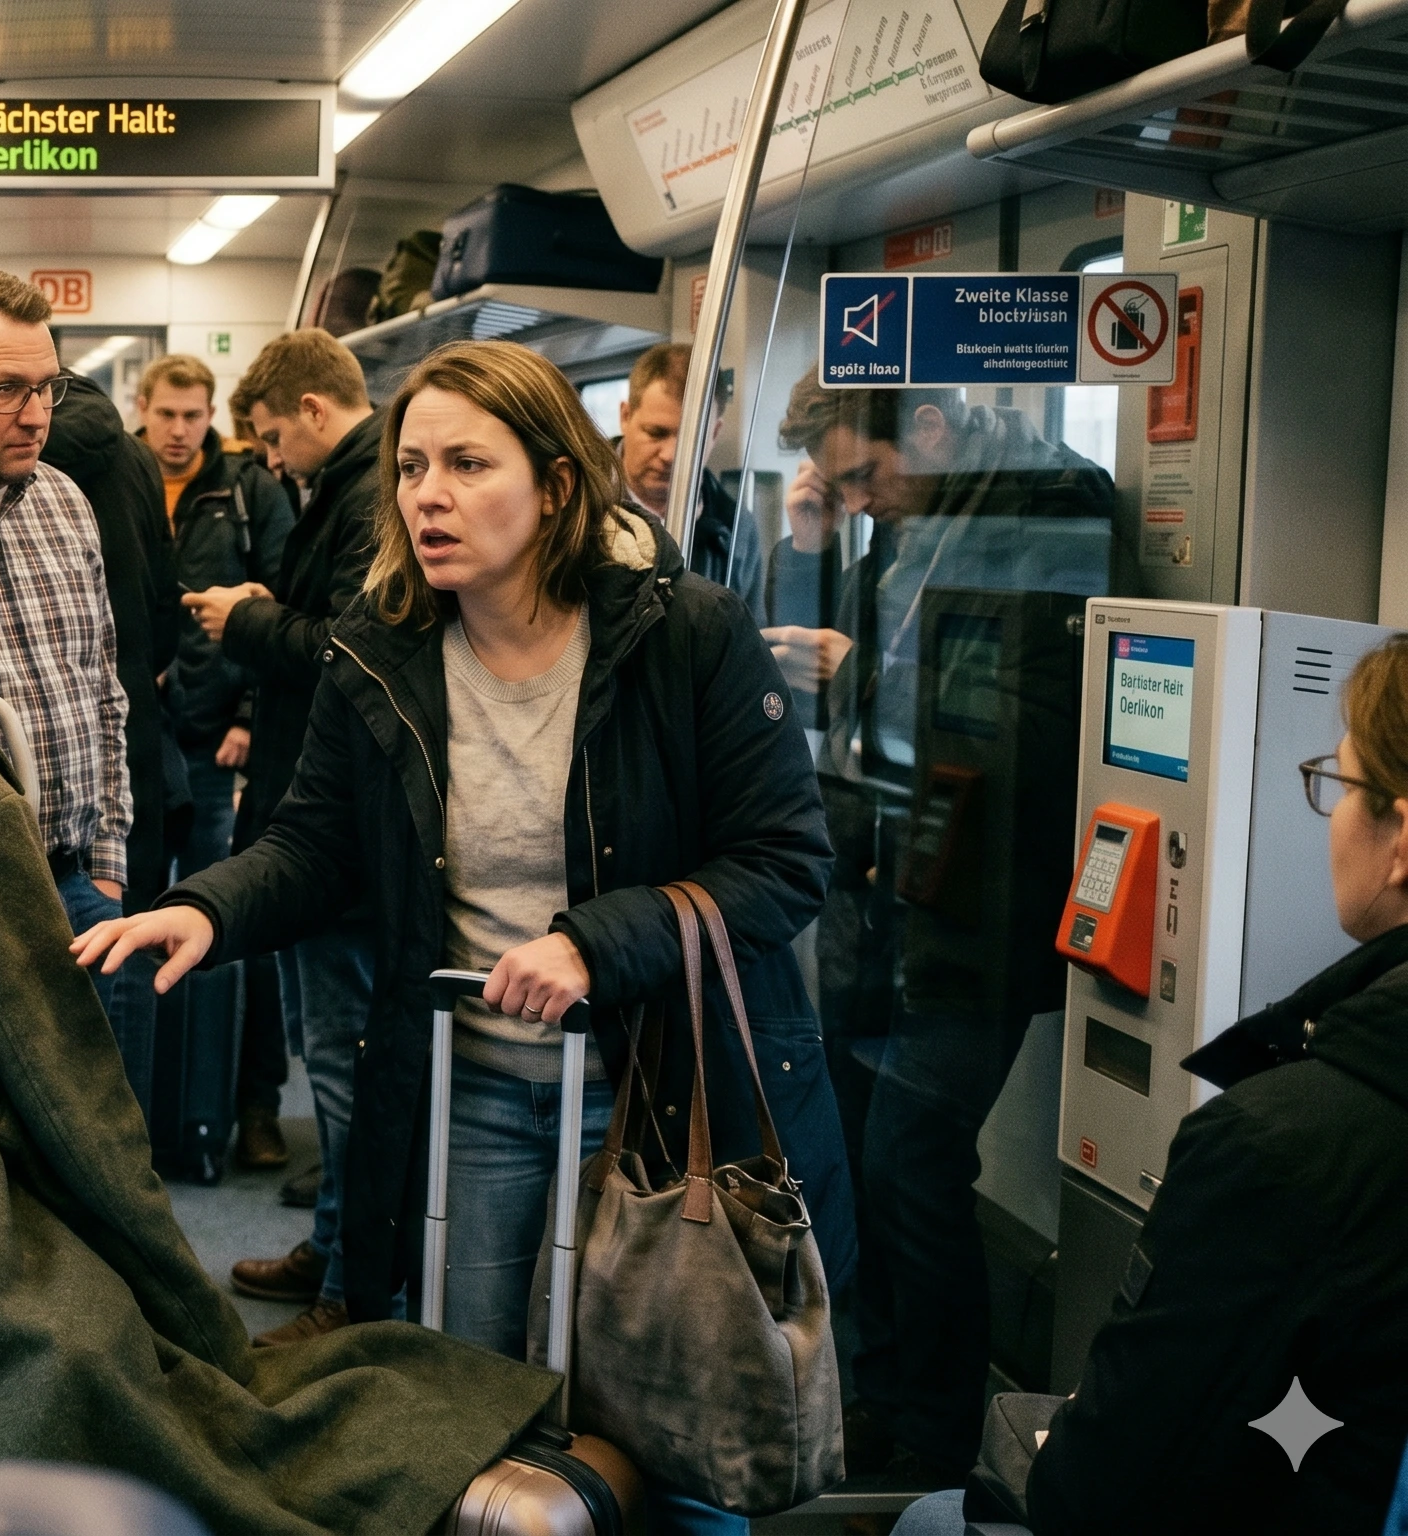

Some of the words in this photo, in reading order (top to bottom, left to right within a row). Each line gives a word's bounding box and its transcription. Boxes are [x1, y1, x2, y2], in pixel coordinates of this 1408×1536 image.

[108, 102, 176, 133] Halt:
[954, 287, 1011, 303] Zweite
[1016, 287, 1069, 303] Klasse
[1120, 695, 1164, 719] Oerlikon
